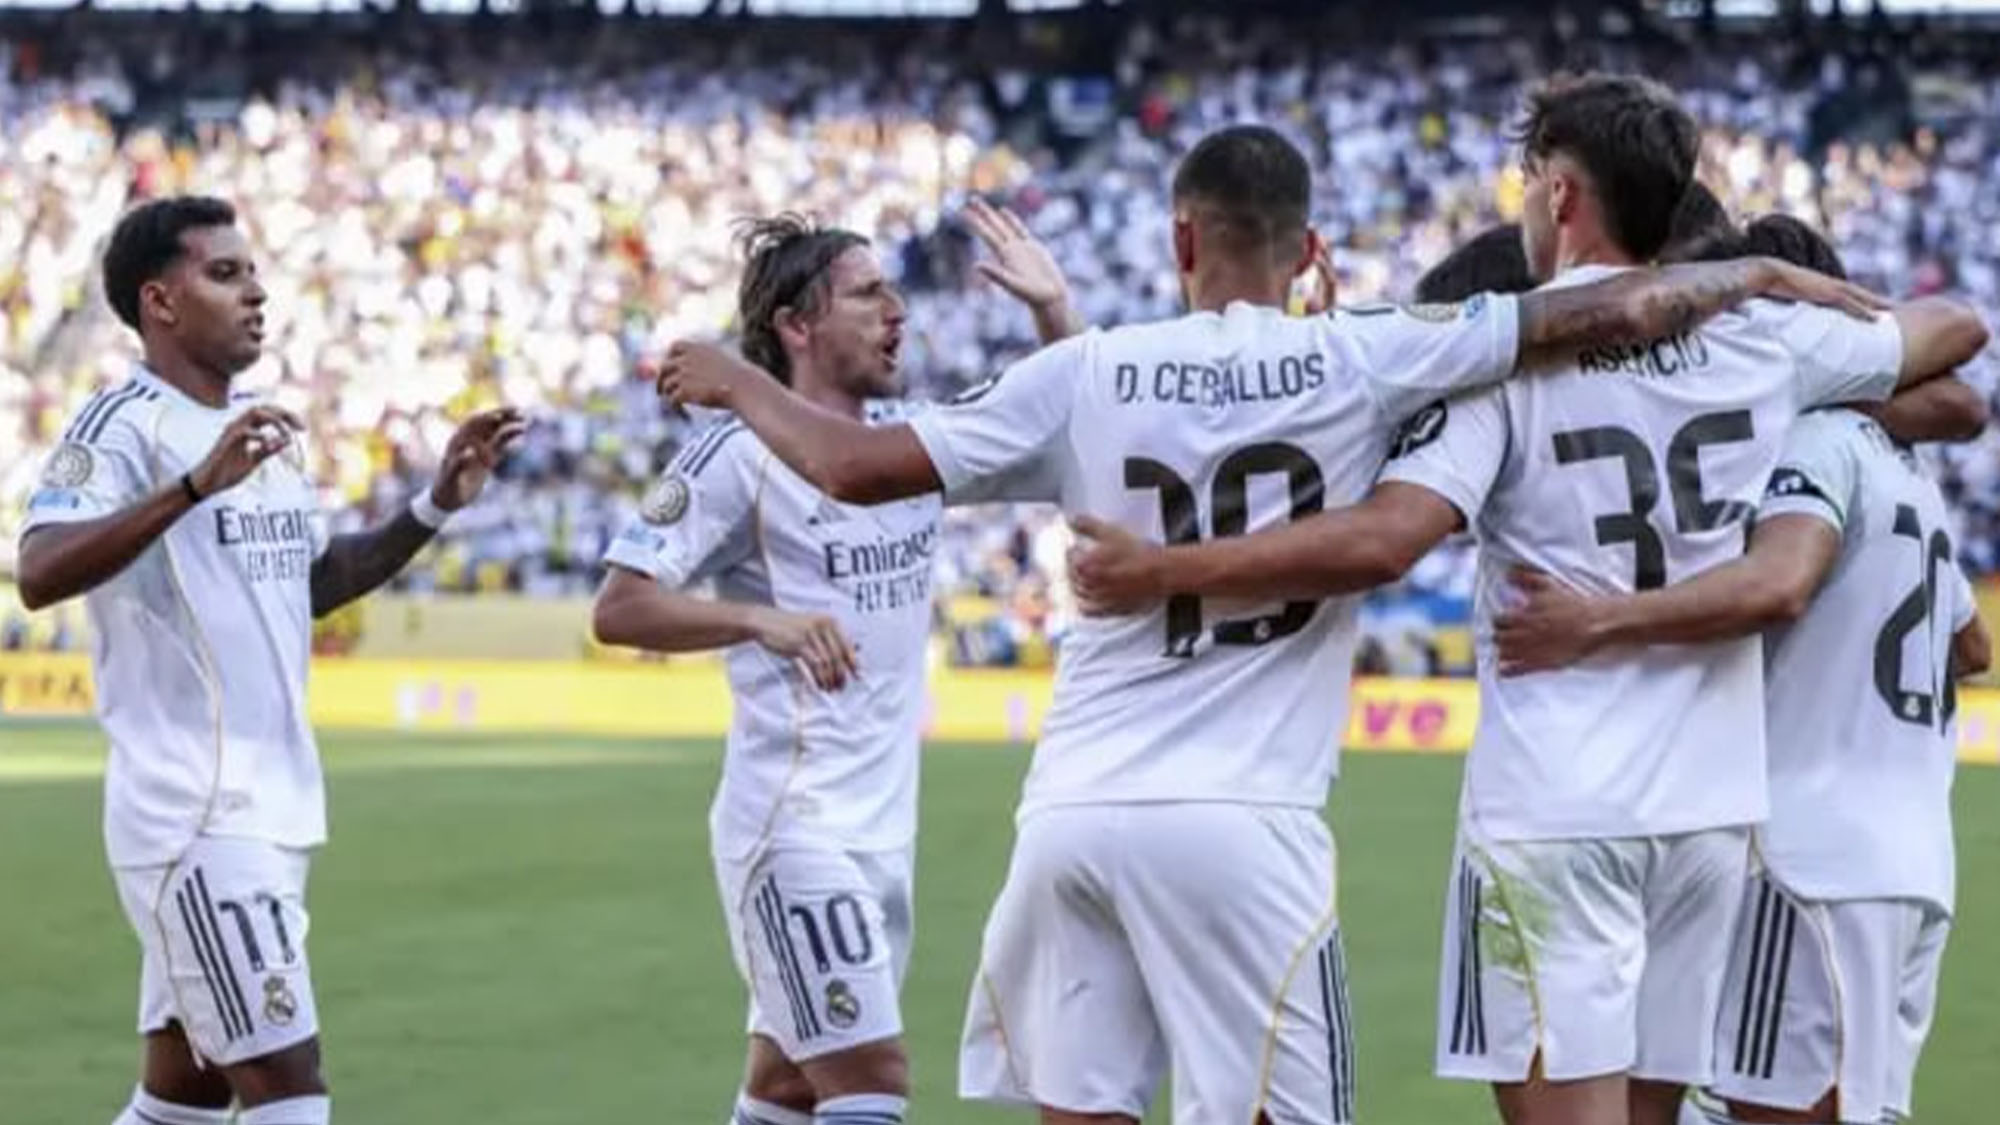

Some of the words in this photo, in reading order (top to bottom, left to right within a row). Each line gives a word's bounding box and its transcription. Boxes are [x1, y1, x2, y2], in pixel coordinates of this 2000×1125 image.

[1115, 362, 1144, 404] D.
[1153, 352, 1325, 407] CEBALLOS
[217, 890, 296, 974] 11
[788, 894, 873, 974] 10
